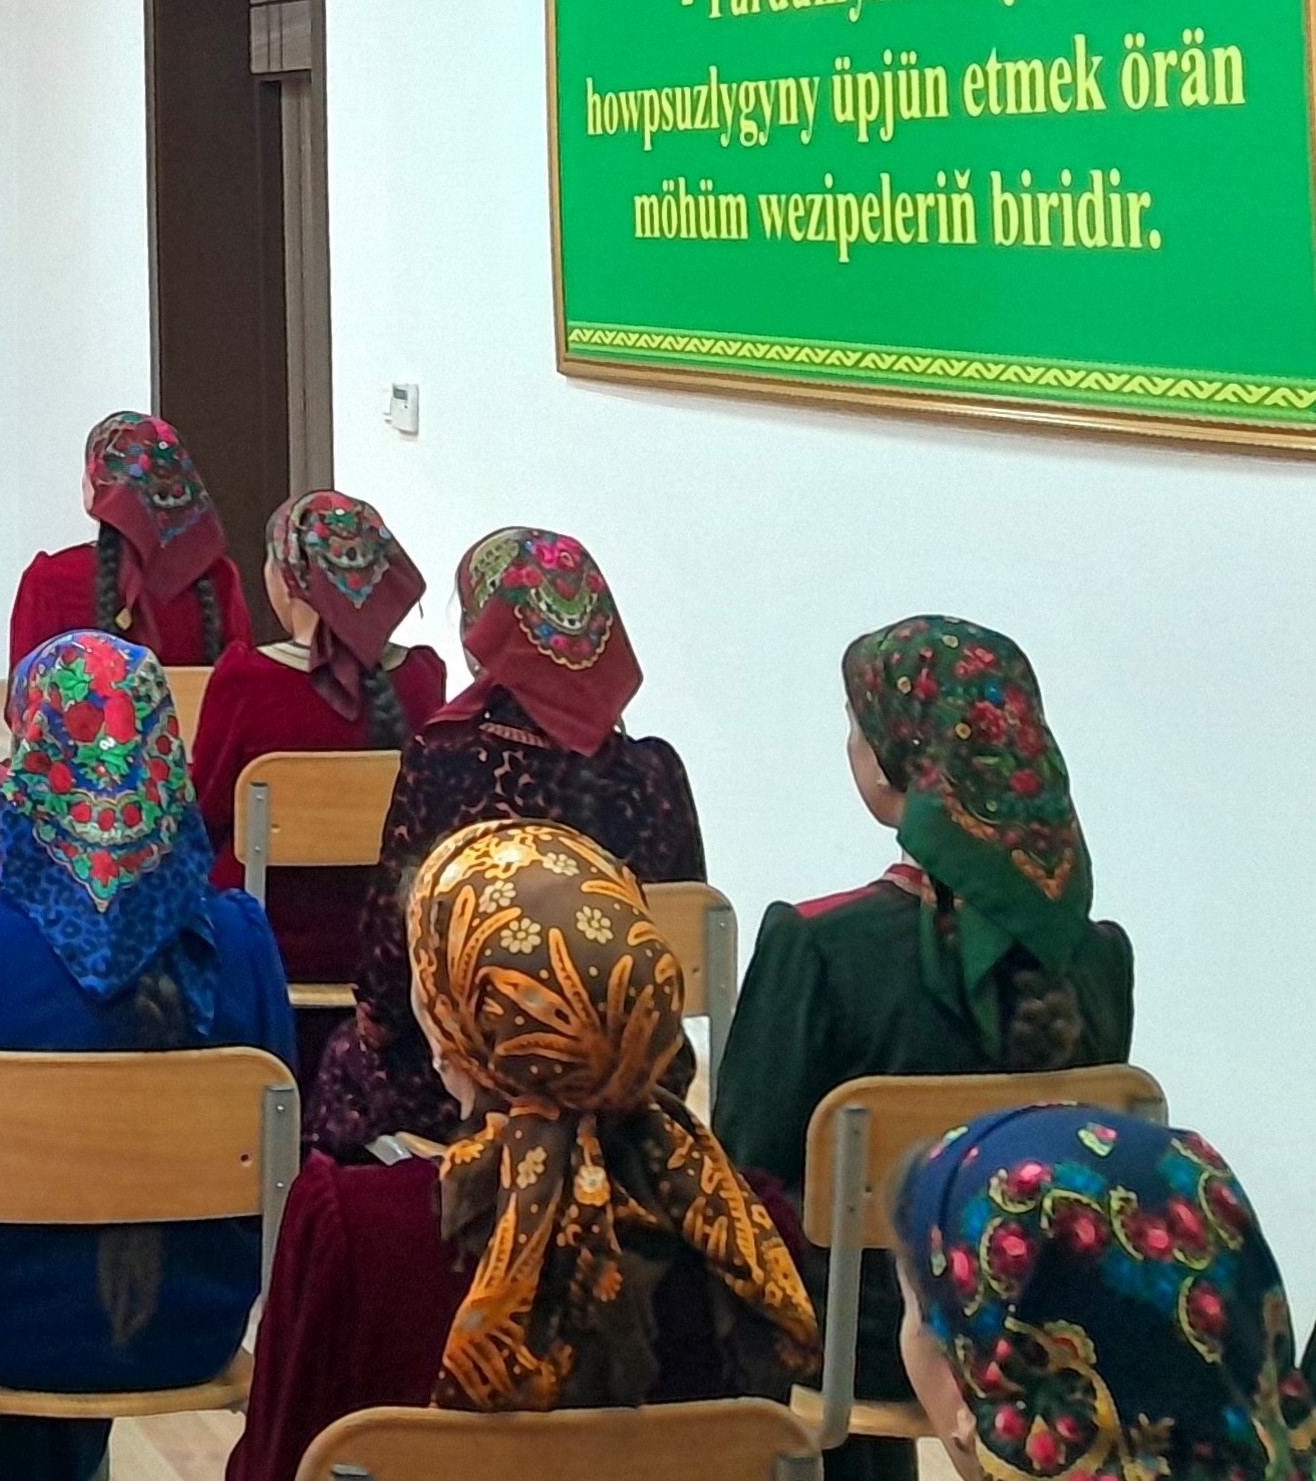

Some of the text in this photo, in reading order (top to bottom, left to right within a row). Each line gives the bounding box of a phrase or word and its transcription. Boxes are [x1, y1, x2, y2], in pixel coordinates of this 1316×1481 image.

[585, 27, 1247, 151] howpsuzlygyny üpjün etmek örän
[633, 167, 1162, 263] möhüm wezipeleriň biridir.
